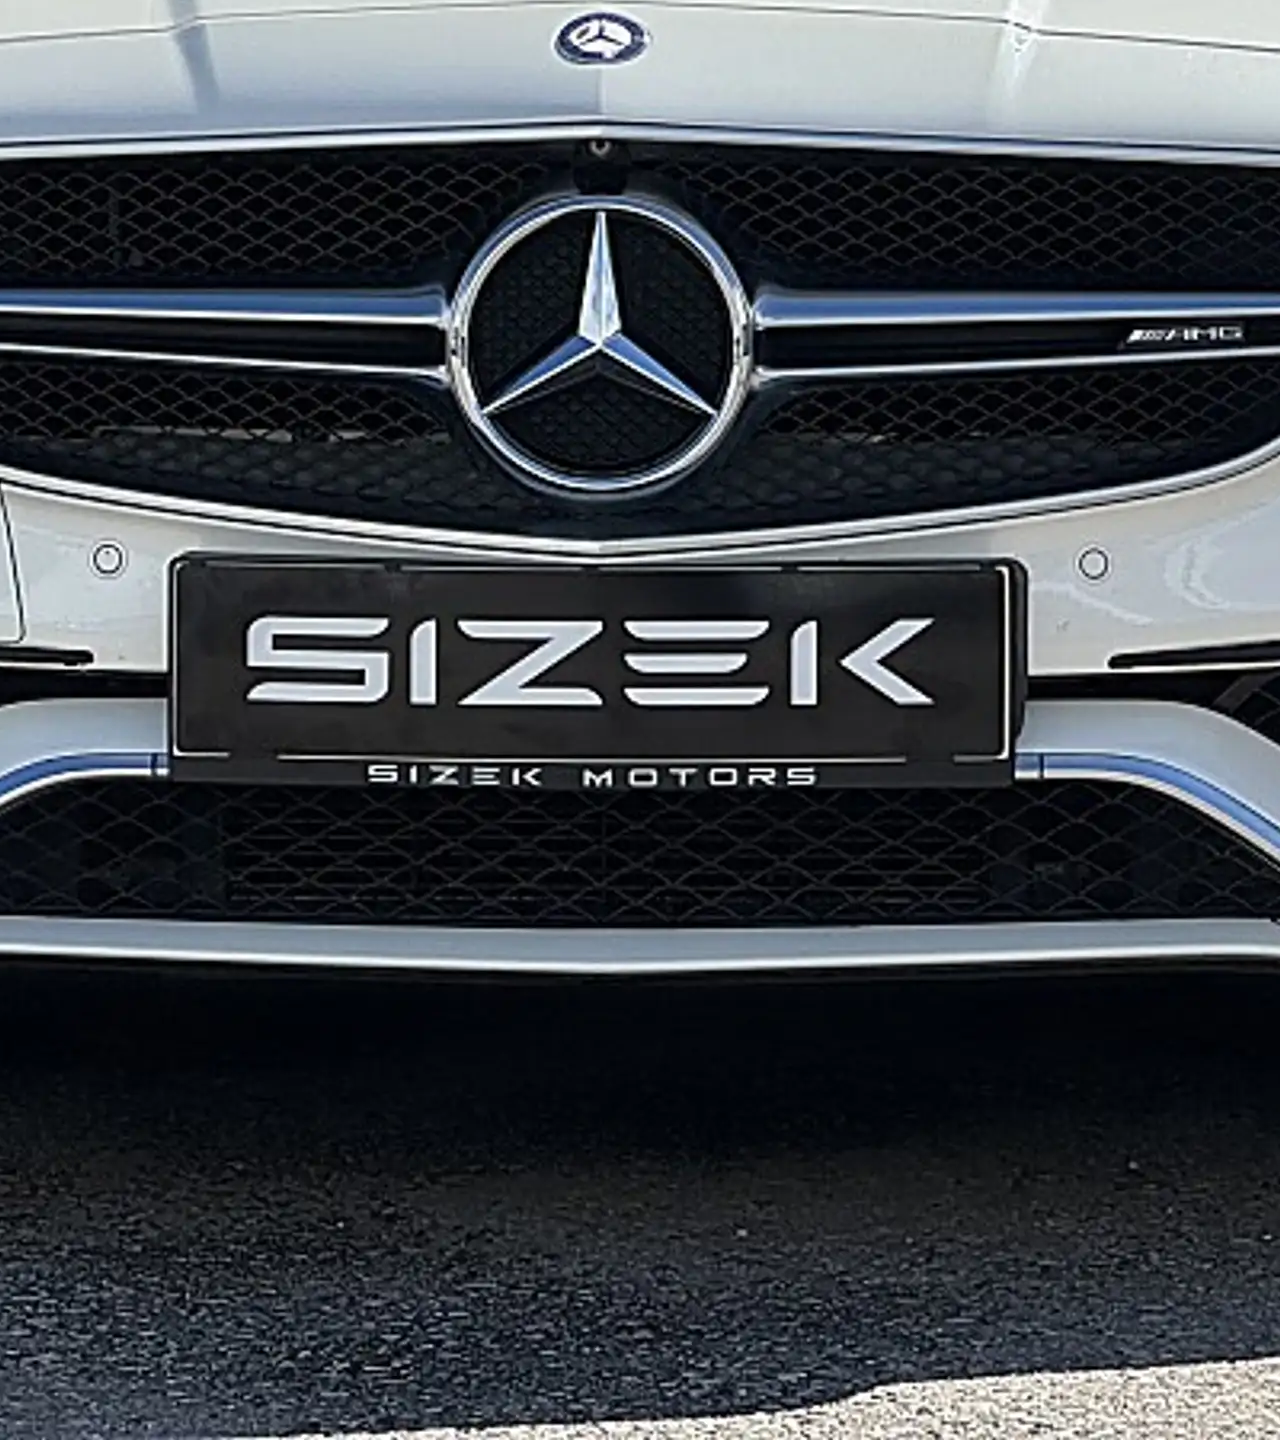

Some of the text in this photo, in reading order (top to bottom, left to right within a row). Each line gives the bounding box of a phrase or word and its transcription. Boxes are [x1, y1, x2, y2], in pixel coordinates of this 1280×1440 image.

[246, 615, 934, 706] SIZEK
[367, 764, 817, 788] SIZEK MOTORS
